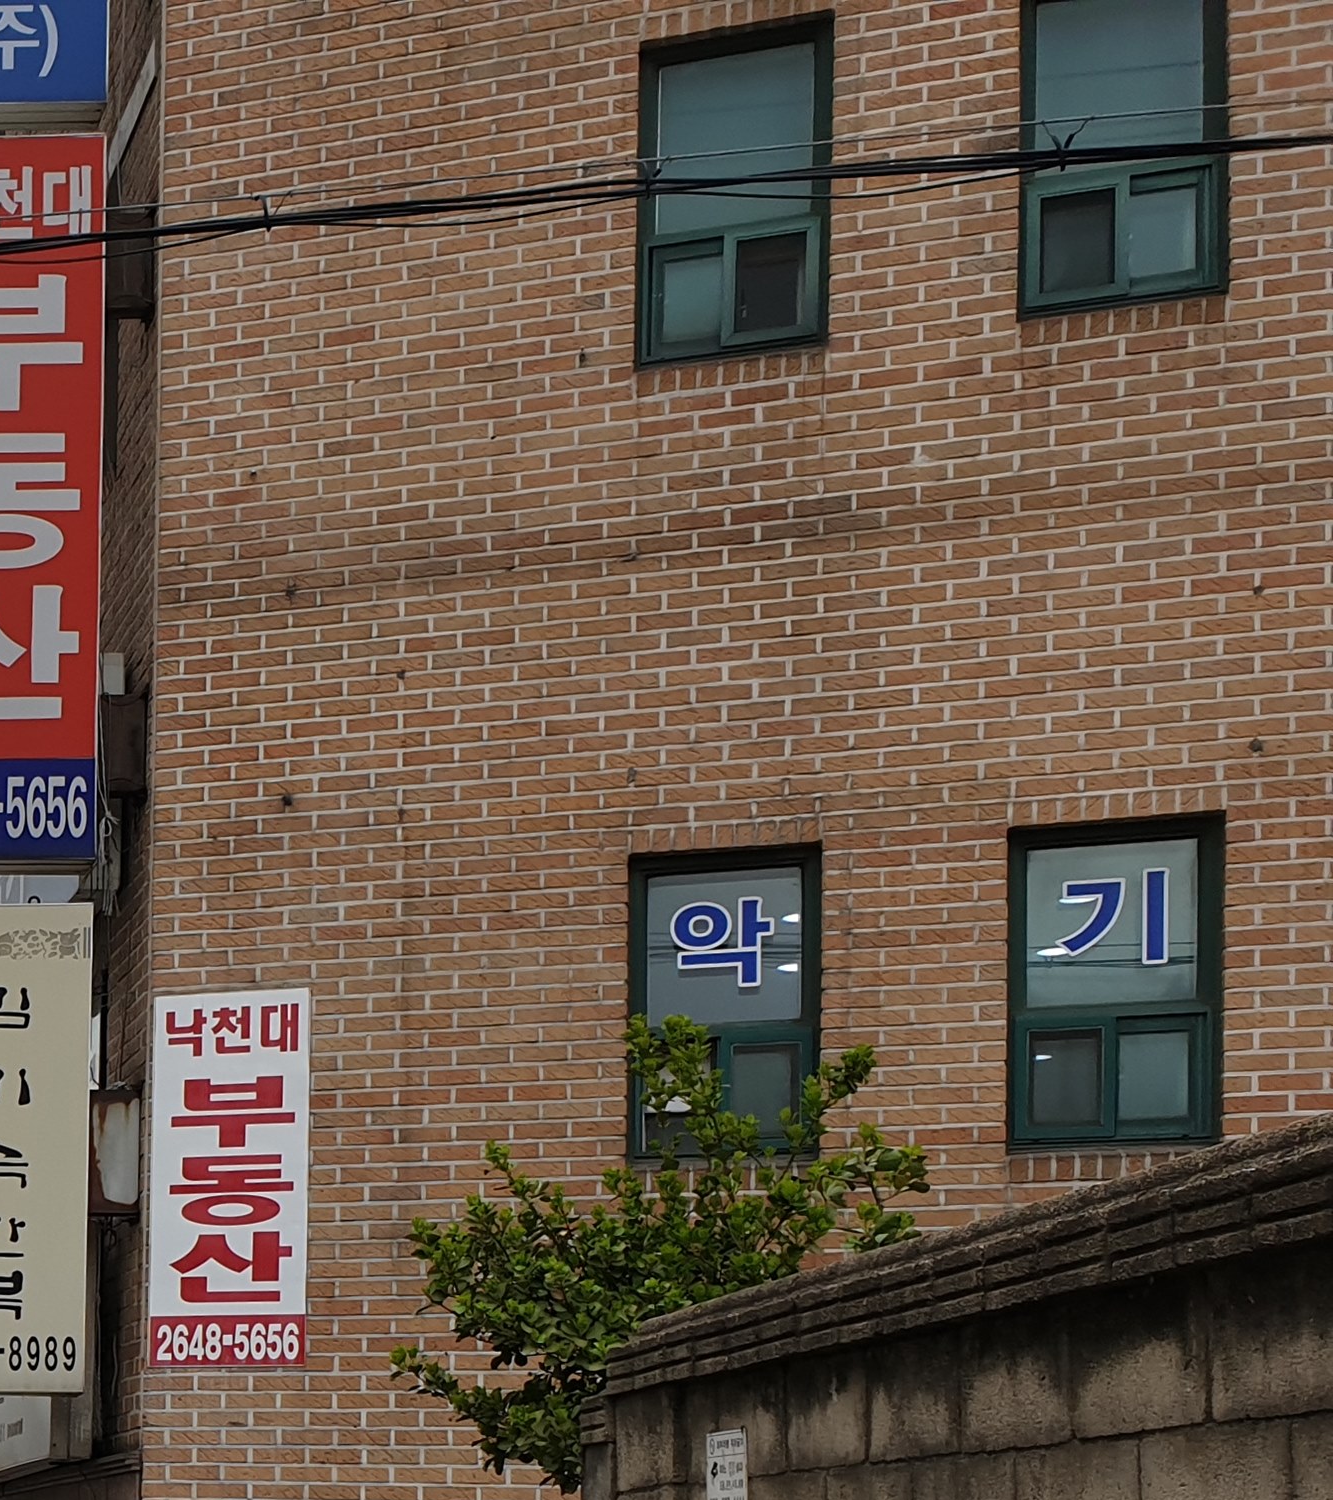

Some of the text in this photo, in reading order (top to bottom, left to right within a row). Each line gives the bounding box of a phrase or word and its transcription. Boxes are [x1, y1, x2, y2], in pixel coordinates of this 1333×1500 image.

[670, 867, 1170, 988] 악 기
[165, 1002, 299, 1057] 낙천대
[169, 1075, 295, 1304] 부동산
[156, 1322, 299, 1361] 2648-5656
